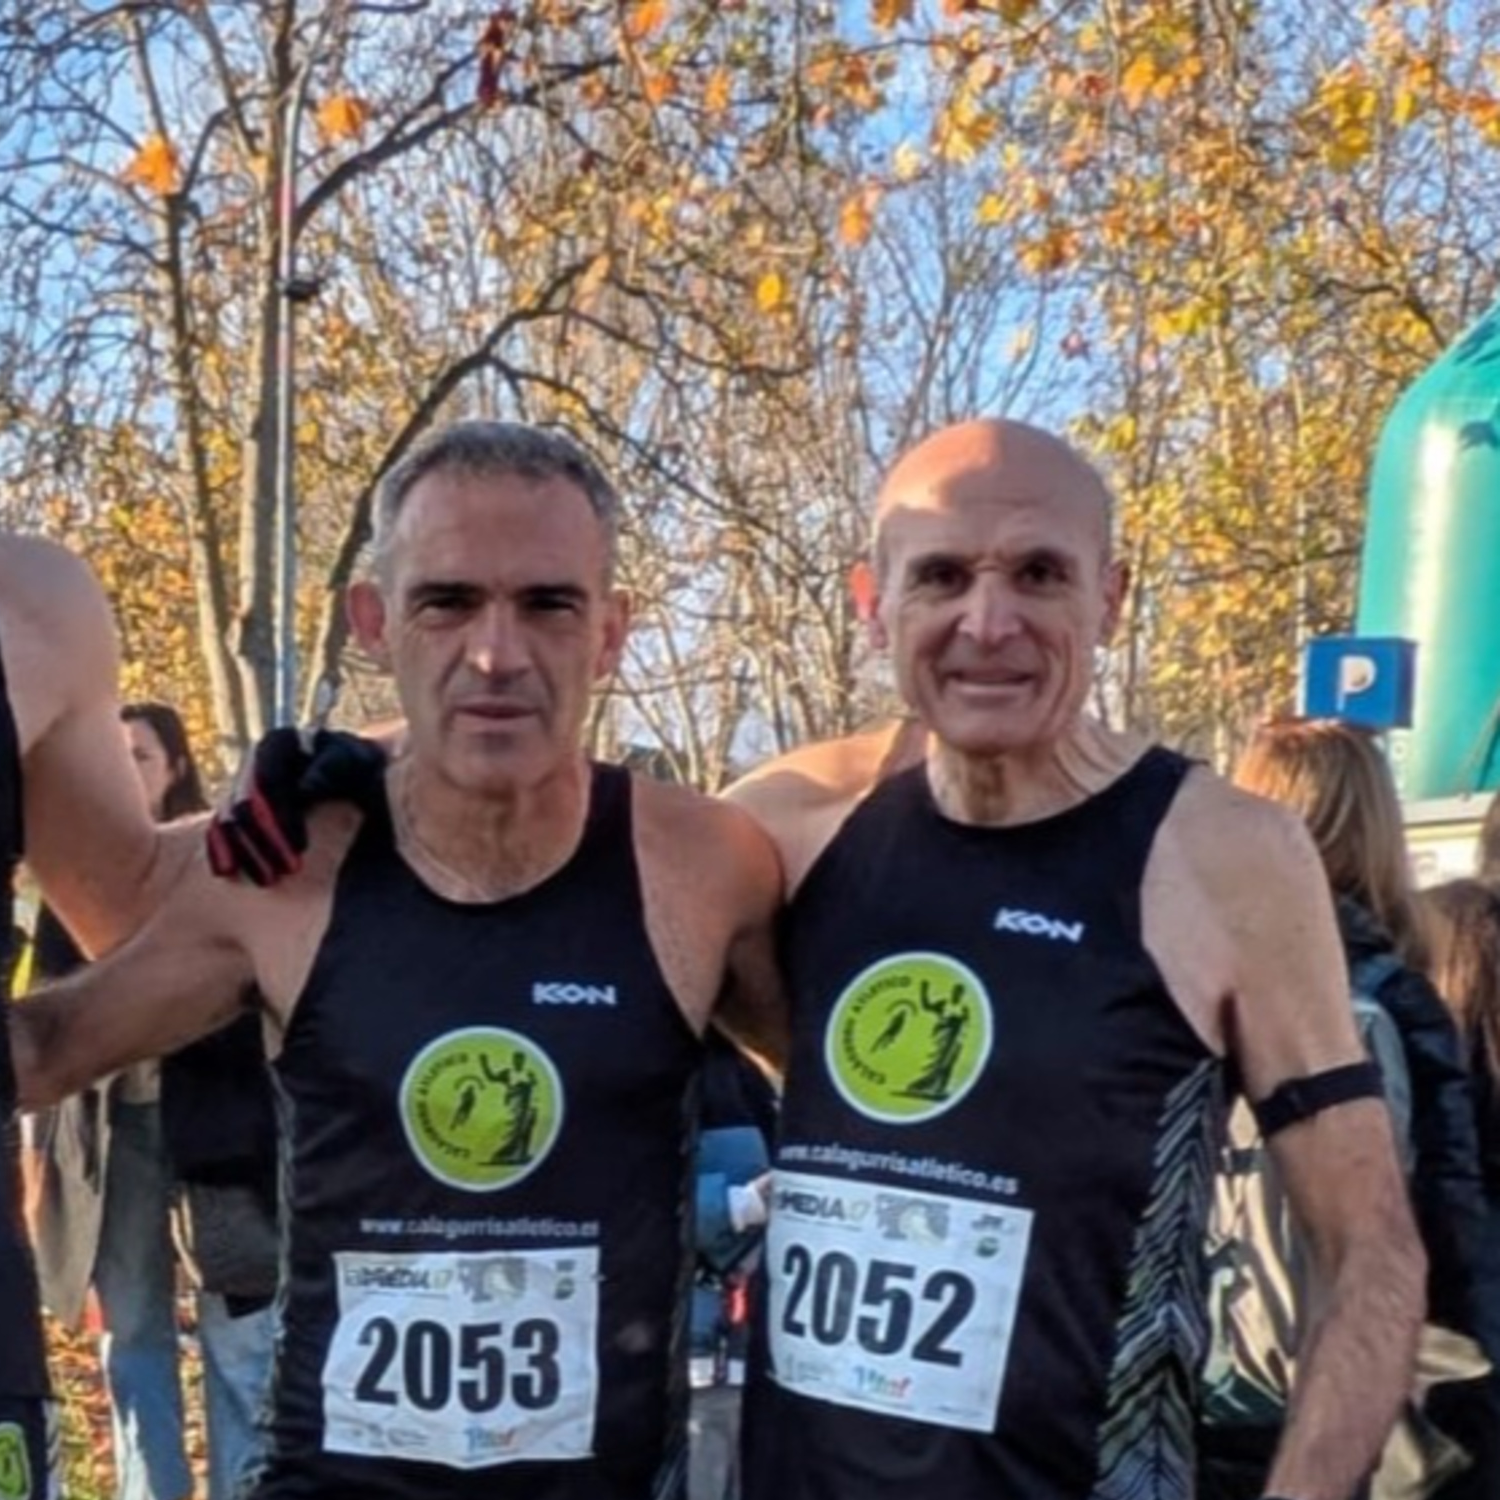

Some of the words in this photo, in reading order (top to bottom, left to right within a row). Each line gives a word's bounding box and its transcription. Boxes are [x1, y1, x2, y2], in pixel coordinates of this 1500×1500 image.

[1336, 654, 1377, 712] P
[782, 1244, 976, 1368] 2052
[355, 1316, 562, 1413] 2053
